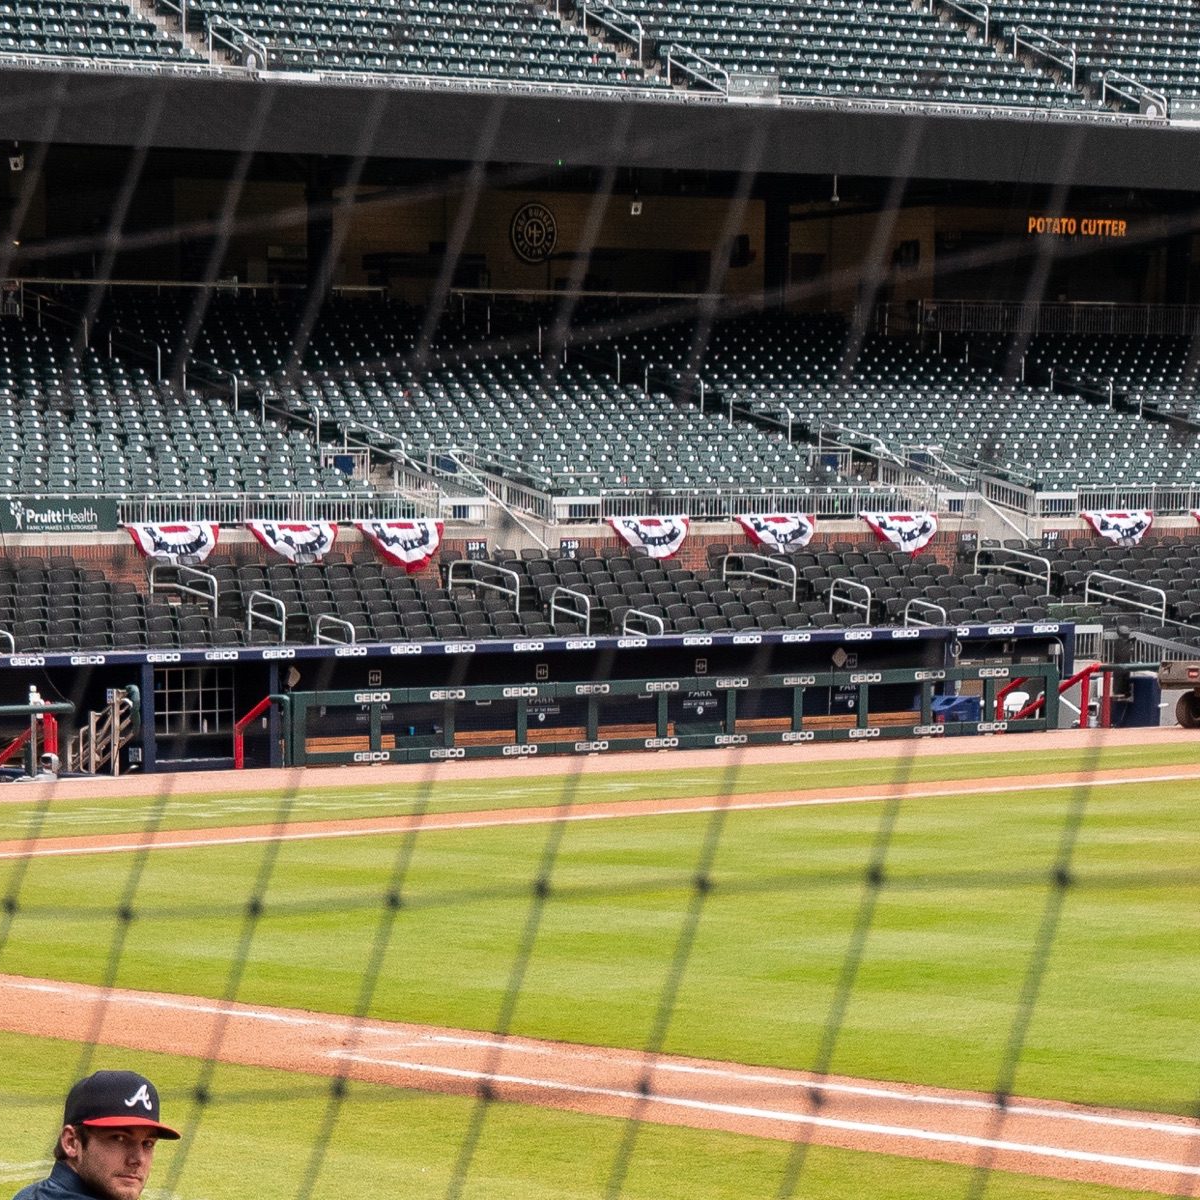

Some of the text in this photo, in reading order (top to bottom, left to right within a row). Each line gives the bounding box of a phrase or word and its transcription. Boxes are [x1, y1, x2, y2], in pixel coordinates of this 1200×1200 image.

[1028, 216, 1126, 237] POTATO CUTTER
[26, 507, 98, 523] PruittHealth
[892, 629, 920, 638] GEICO
[988, 626, 1014, 634] GEICO
[1033, 625, 1059, 633] GEICO
[683, 636, 712, 645] GEICO
[733, 635, 762, 644] GEICO
[782, 634, 811, 643] GEICO
[844, 631, 872, 640] GEICO
[444, 644, 476, 653] GEICO
[513, 642, 544, 652] GEICO
[566, 640, 596, 650] GEICO
[618, 639, 647, 648] GEICO
[262, 649, 295, 659] GEICO
[335, 647, 367, 656] GEICO
[390, 645, 422, 655] GEICO
[70, 655, 105, 665] GEICO
[146, 653, 181, 663] GEICO
[205, 651, 239, 661] GEICO
[10, 657, 45, 666] GEICO
[850, 673, 882, 683] GEICO
[915, 670, 945, 680] GEICO
[978, 668, 1009, 678] GEICO
[716, 678, 749, 688] GEICO
[783, 676, 815, 686] GEICO
[575, 684, 610, 695] GEICO
[646, 681, 679, 692] GEICO
[429, 689, 466, 700] GEICO
[503, 687, 538, 697] GEICO
[354, 692, 391, 703] GEICO
[849, 727, 880, 737] GEICO
[913, 725, 944, 735] GEICO
[977, 722, 1008, 732] GEICO
[715, 734, 747, 745] GEICO
[782, 731, 814, 741] GEICO
[574, 741, 609, 751] GEICO
[645, 737, 678, 748] GEICO
[429, 748, 465, 758] GEICO
[502, 744, 538, 755] GEICO
[353, 751, 390, 762] GEICO
